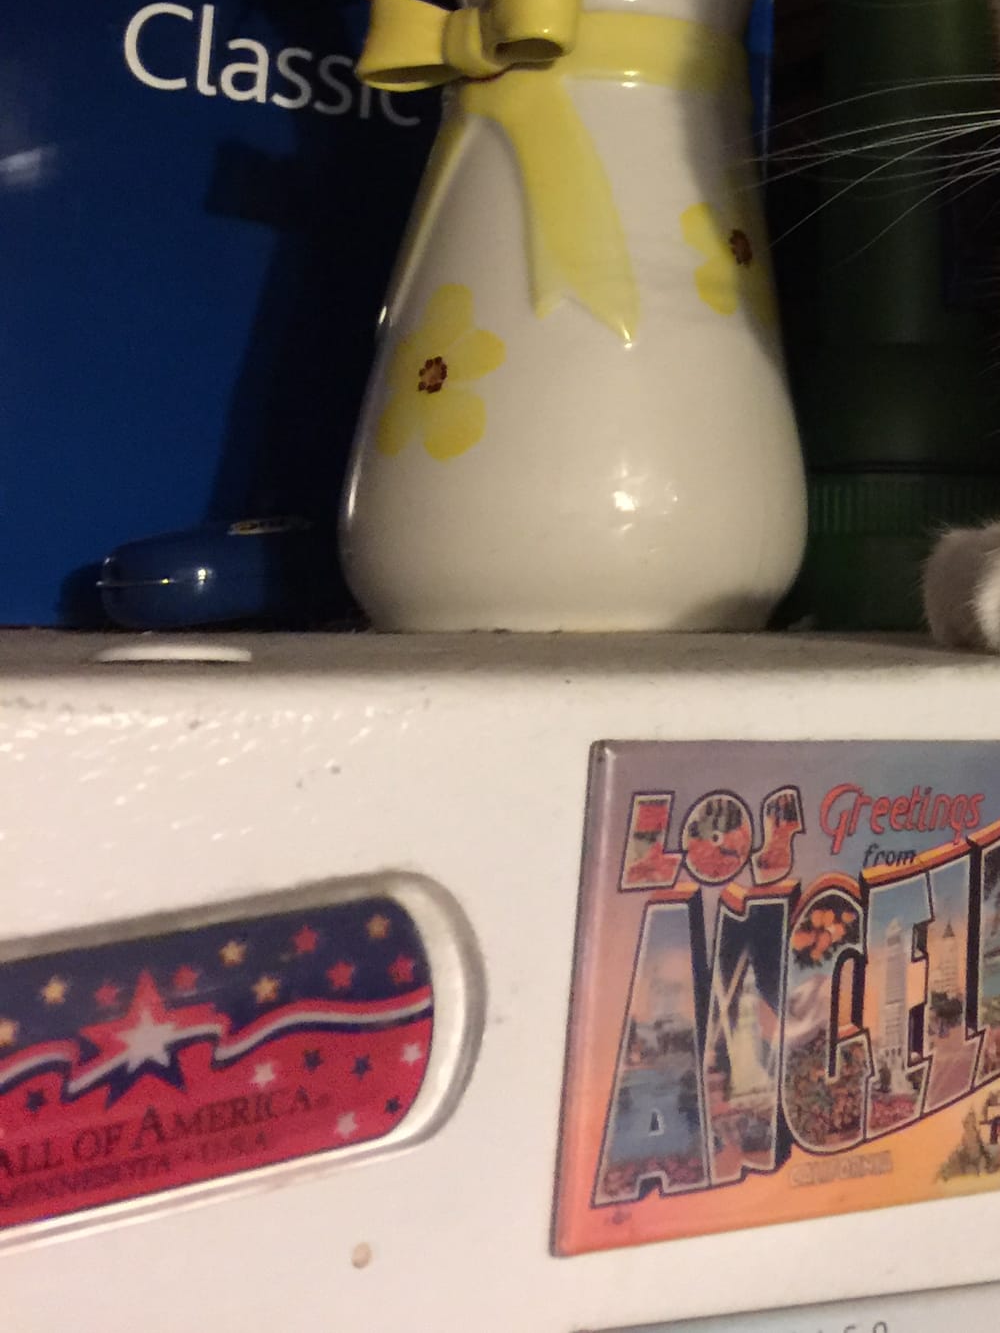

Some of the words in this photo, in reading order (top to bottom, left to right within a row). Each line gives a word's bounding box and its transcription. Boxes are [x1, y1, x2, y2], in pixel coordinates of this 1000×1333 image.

[617, 784, 806, 894] LOS
[819, 782, 986, 856] Greetings
[863, 843, 918, 867] from
[71, 1120, 127, 1163] OF
